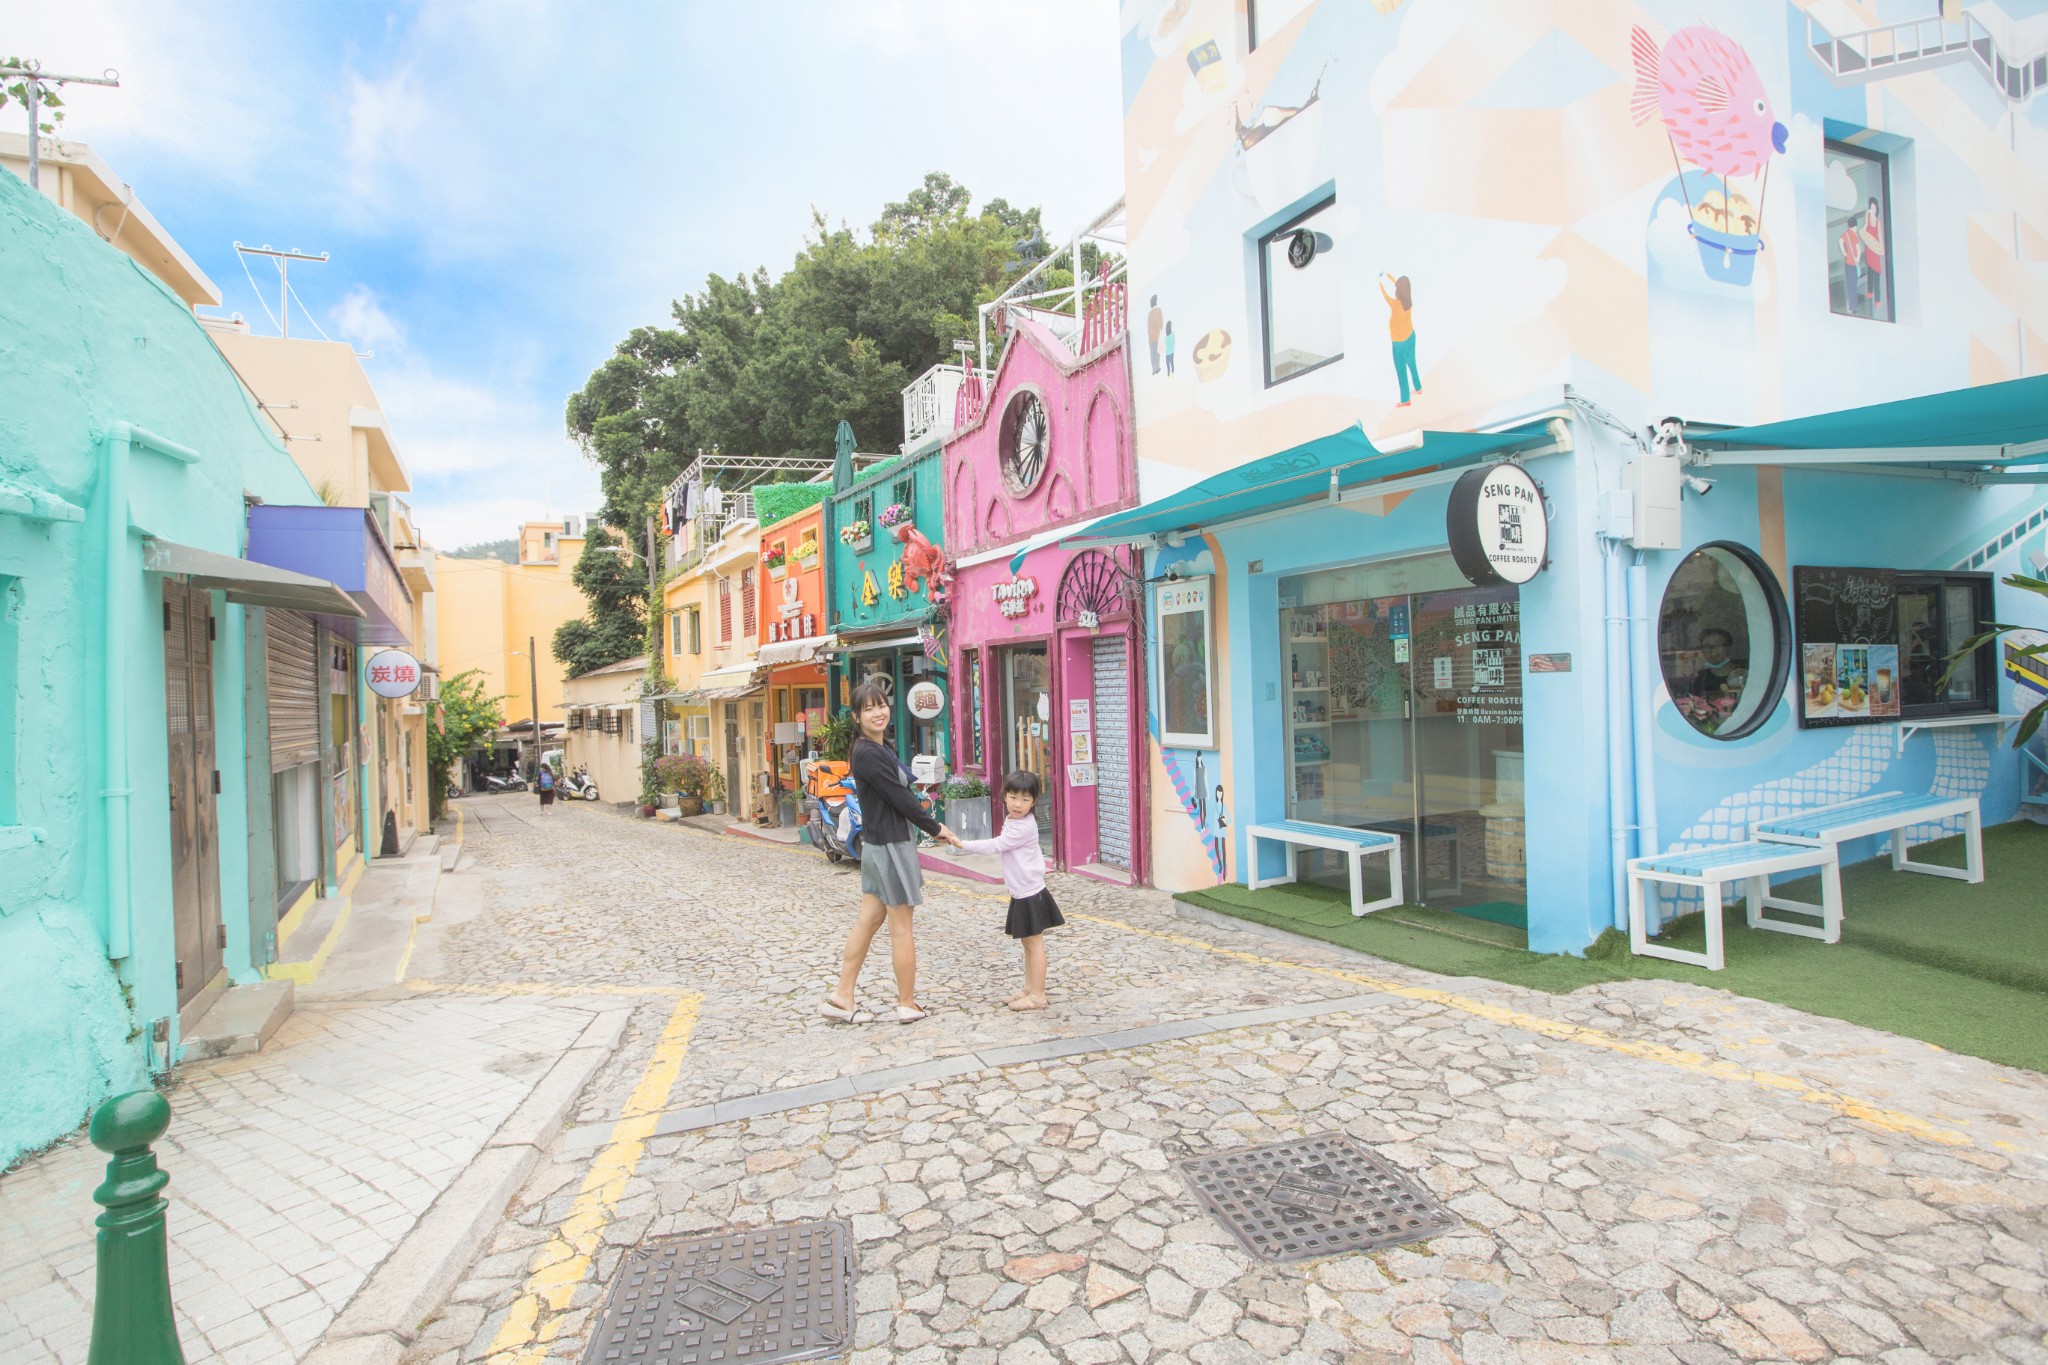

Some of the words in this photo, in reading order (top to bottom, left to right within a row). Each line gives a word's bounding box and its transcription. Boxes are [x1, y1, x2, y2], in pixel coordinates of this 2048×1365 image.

[1484, 484, 1511, 498] SENG
[1514, 486, 1534, 504] PAN
[1488, 554, 1511, 563] COFFEE
[1512, 555, 1538, 564] ROASTER
[1455, 617, 1475, 626] SENG
[1475, 616, 1492, 624] PAN
[1455, 629, 1490, 647] SENG
[371, 665, 415, 683] 炭燒
[1456, 696, 1486, 704] COFFEE
